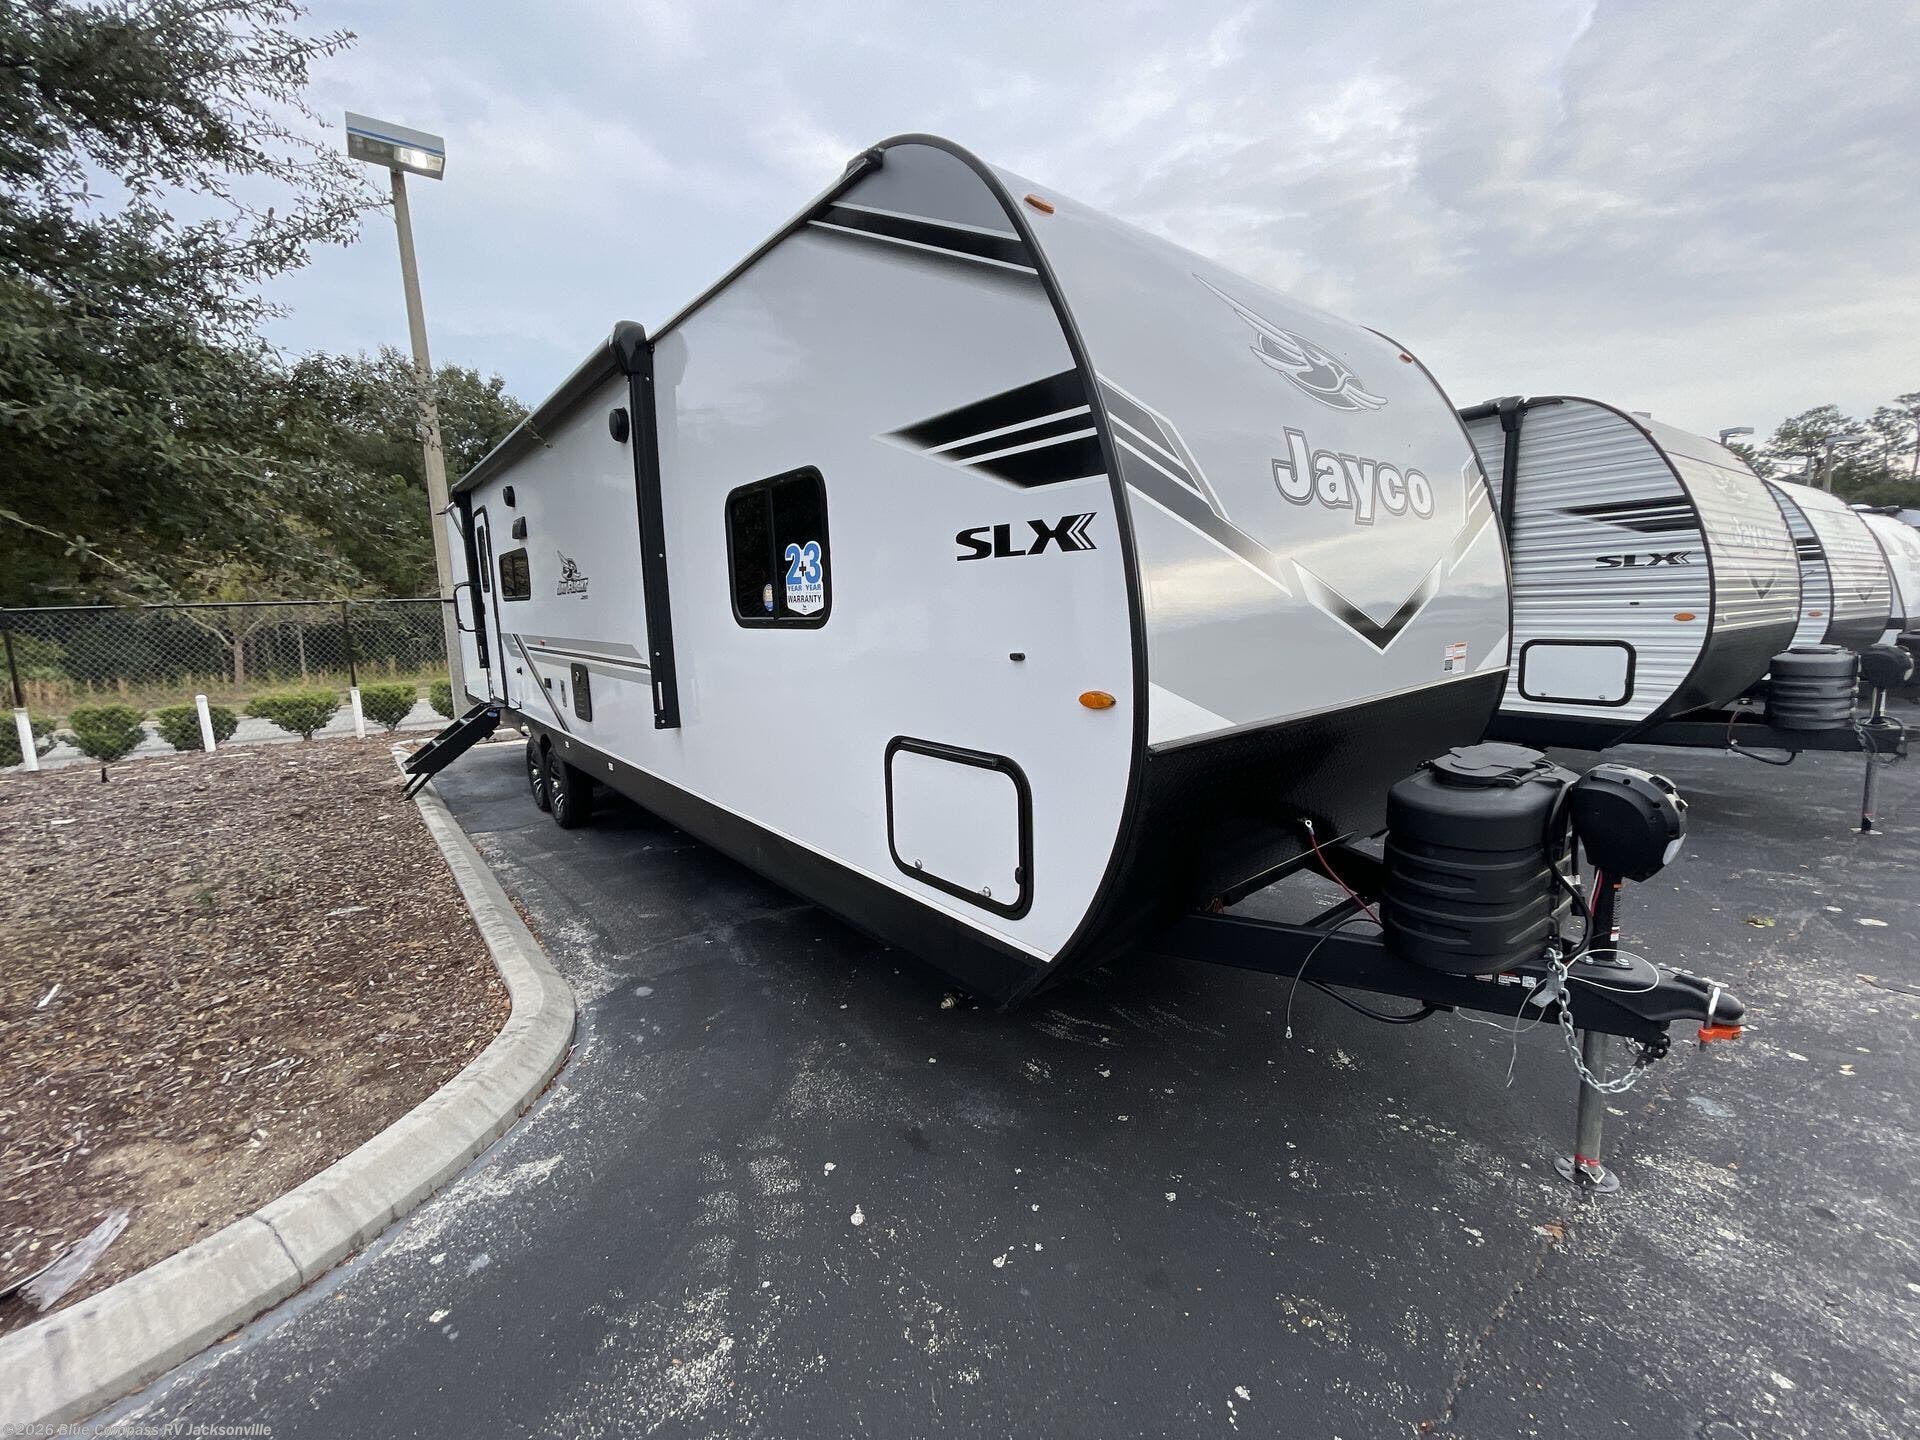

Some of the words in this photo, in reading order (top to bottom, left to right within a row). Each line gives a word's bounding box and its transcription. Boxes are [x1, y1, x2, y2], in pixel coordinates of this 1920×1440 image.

[1272, 426, 1435, 526] Jayco
[956, 512, 1097, 561] SLX
[1595, 551, 1692, 568] SLX
[788, 595, 822, 603] WARRANTY
